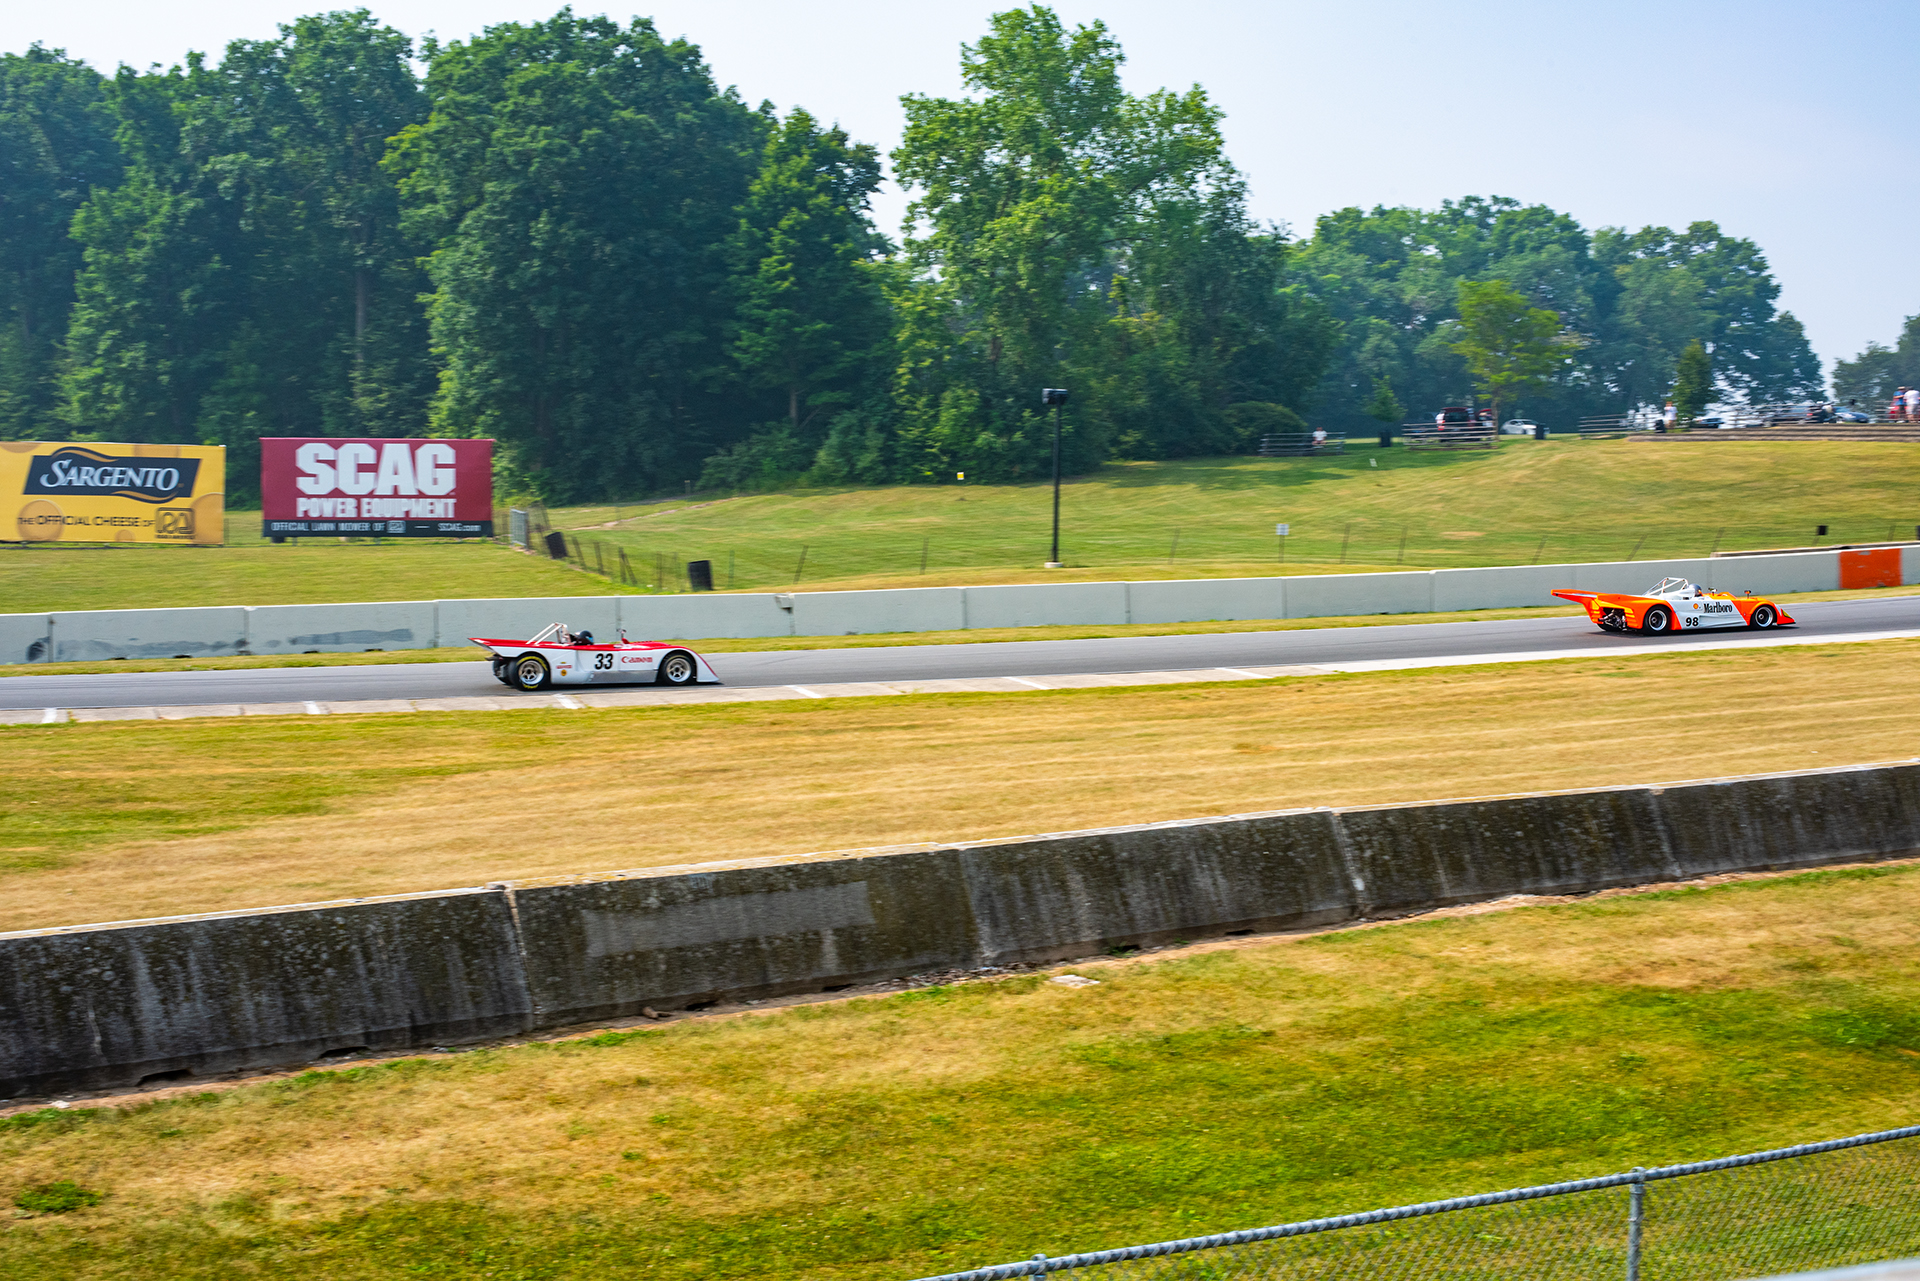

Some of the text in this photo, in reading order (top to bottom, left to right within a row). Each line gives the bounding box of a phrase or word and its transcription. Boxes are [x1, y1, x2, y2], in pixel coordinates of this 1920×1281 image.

[40, 459, 180, 491] SARGENTO
[296, 443, 456, 495] SCAG
[296, 498, 457, 518] POWER EQUIPMENT
[36, 515, 91, 526] OFFICIAL
[92, 516, 141, 527] CHEESE
[142, 519, 156, 527] OF
[271, 522, 310, 531] OFFICIAL
[372, 523, 385, 531] OF
[1703, 601, 1733, 613] Marlboro
[1685, 616, 1699, 627] 98
[594, 653, 613, 670] 33
